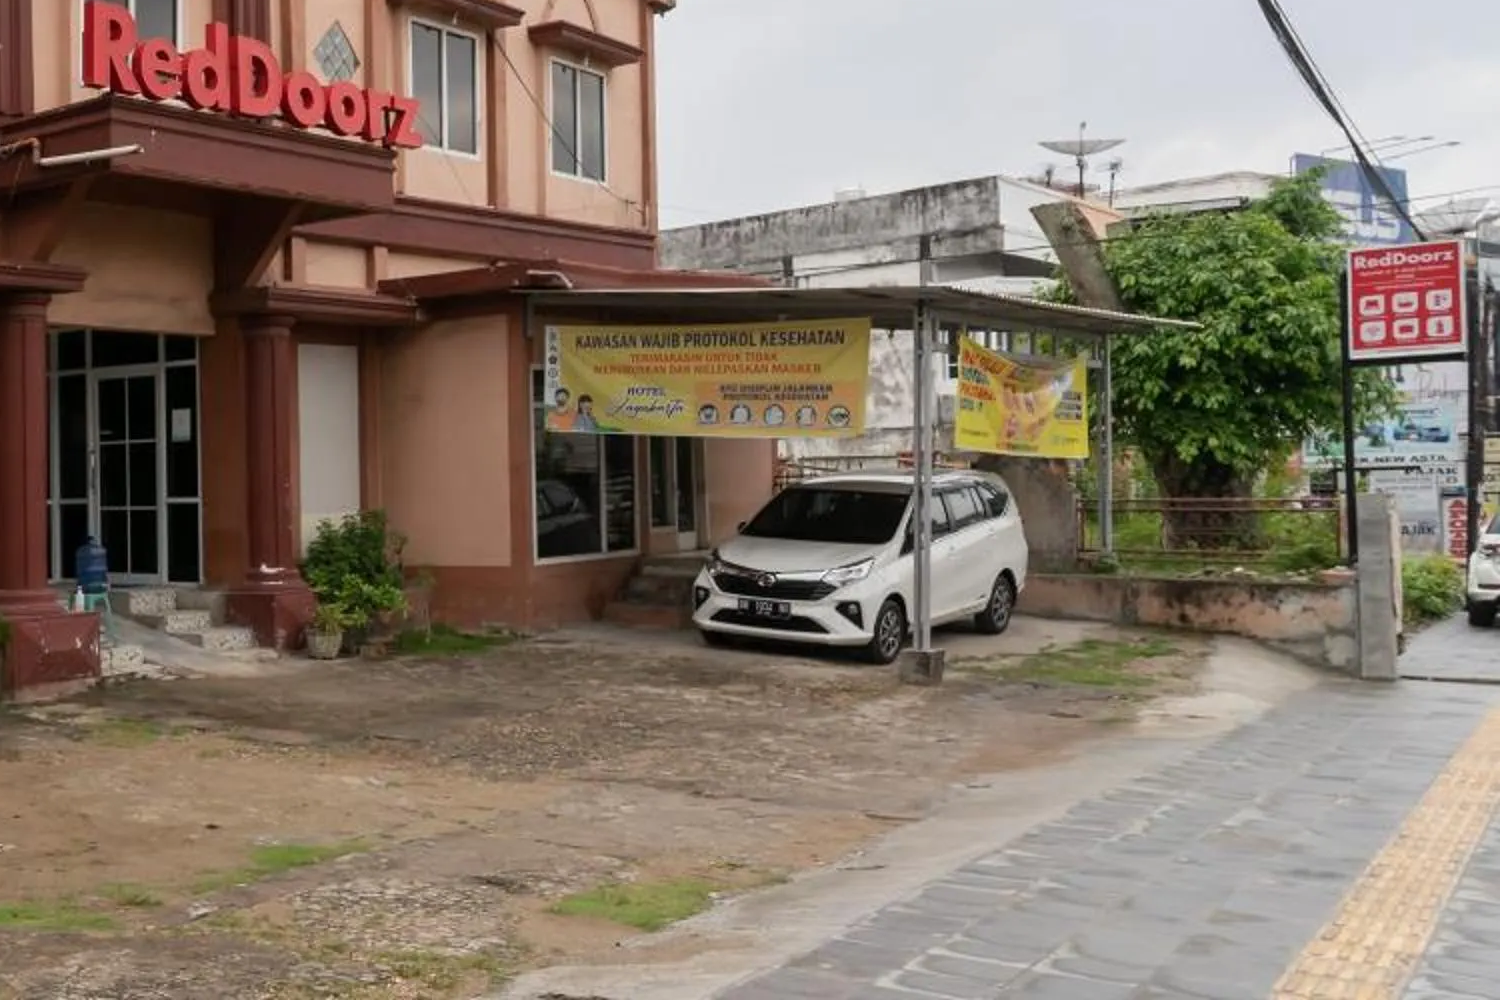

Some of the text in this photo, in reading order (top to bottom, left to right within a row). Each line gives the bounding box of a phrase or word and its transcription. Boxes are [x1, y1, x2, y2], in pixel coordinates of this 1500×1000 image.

[82, 0, 423, 149] RedDoorz
[1353, 251, 1456, 271] RedDoorz
[576, 329, 846, 349] KAWASAN WAJIB PROTOKOL KESEHATAN
